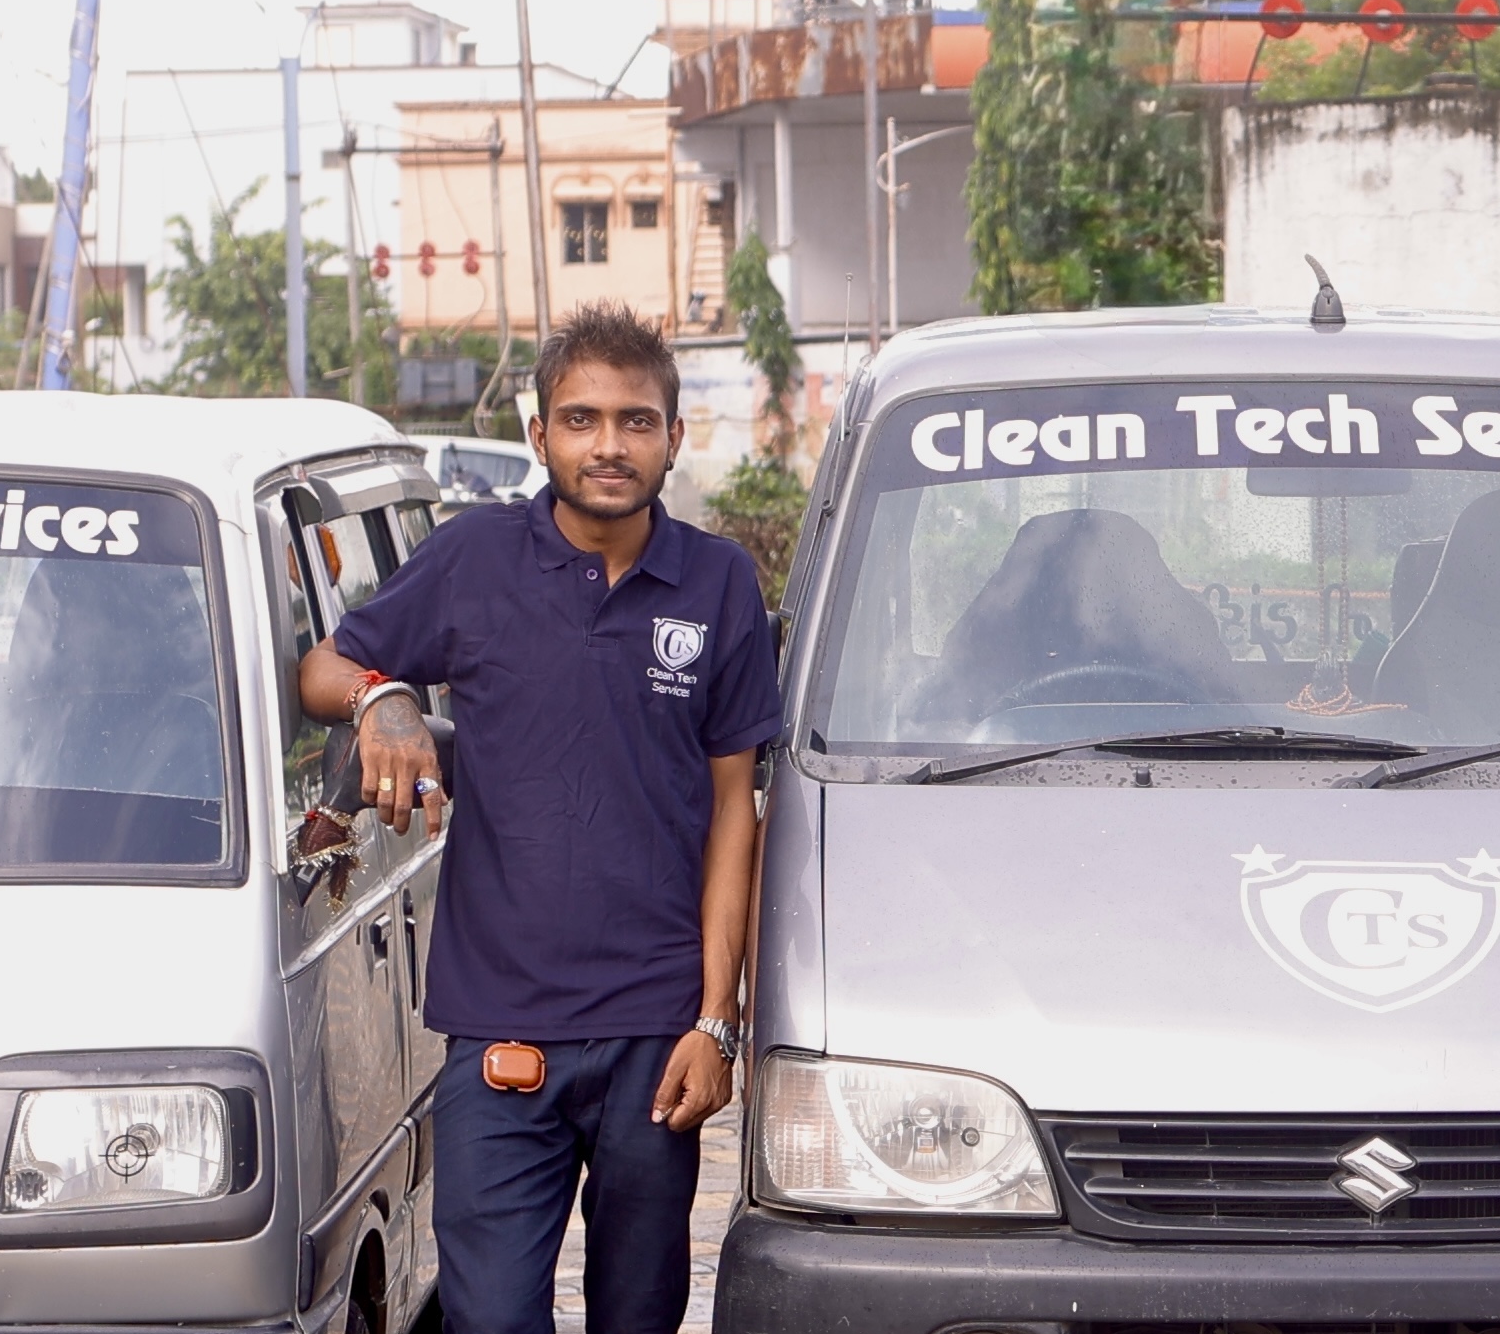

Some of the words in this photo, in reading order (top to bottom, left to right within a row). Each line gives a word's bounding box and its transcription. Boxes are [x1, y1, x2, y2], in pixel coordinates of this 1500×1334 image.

[911, 409, 1146, 471] Clean
[1175, 394, 1379, 456] Tech
[664, 629, 694, 660] CTS
[646, 667, 675, 681] Clean
[676, 672, 698, 685] Tech
[651, 681, 691, 698] Services
[1299, 887, 1449, 969] CTS
